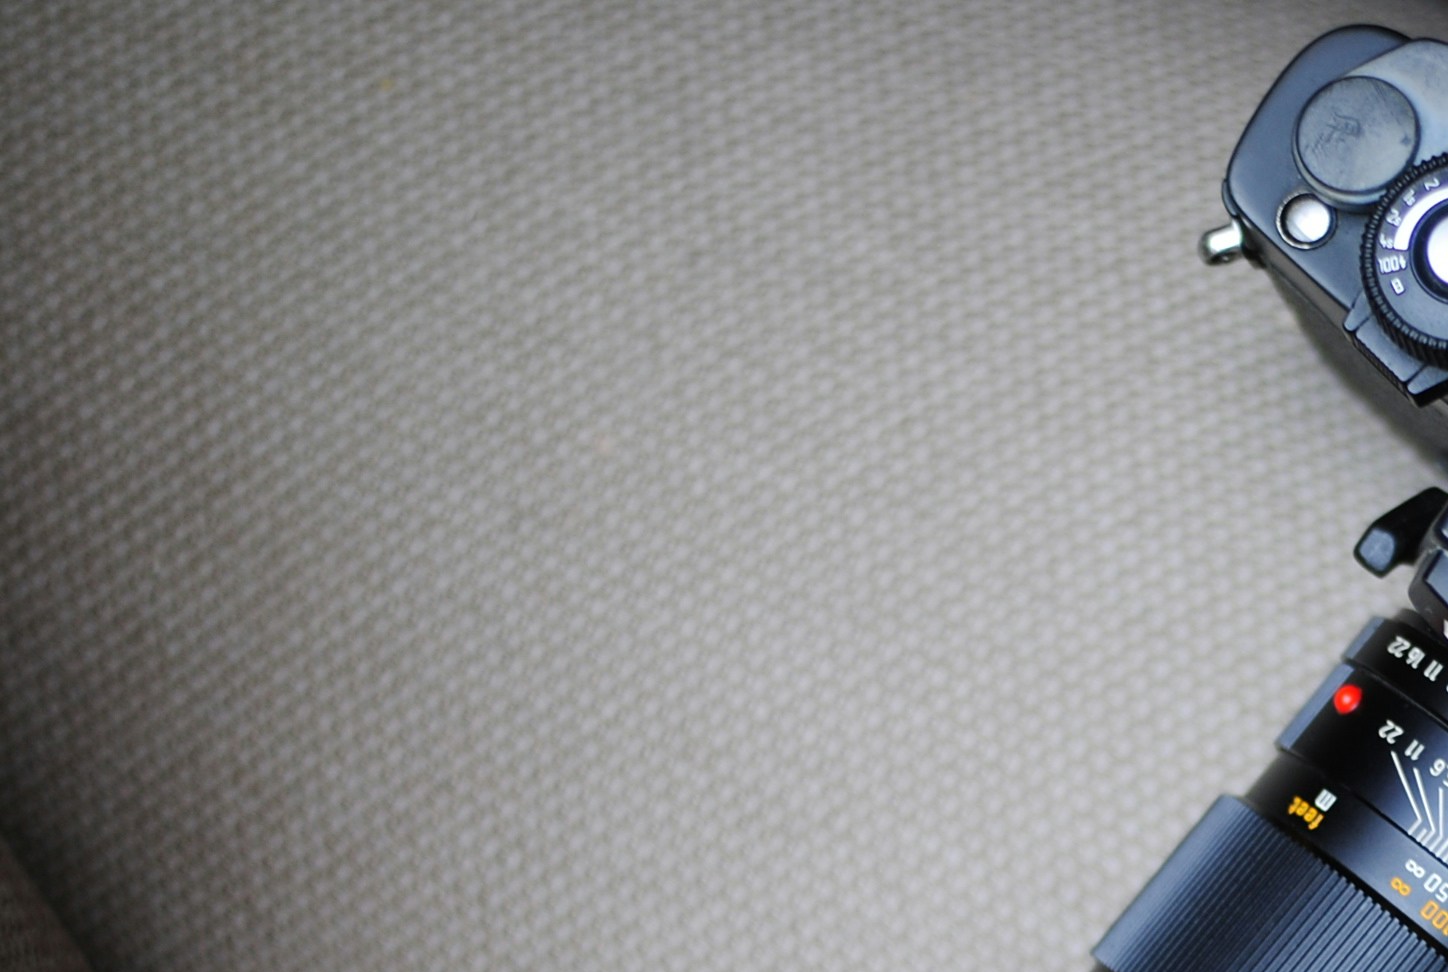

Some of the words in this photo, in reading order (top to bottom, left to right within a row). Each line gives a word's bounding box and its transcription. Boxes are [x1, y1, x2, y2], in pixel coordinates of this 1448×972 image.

[1424, 178, 1439, 190] 2
[1378, 256, 1398, 274] 100
[1387, 635, 1411, 658] 22
[1406, 646, 1425, 669] 16
[1424, 660, 1444, 682] 11
[1378, 719, 1404, 744] 22
[1404, 739, 1425, 761] 11
[1288, 796, 1324, 830] feet
